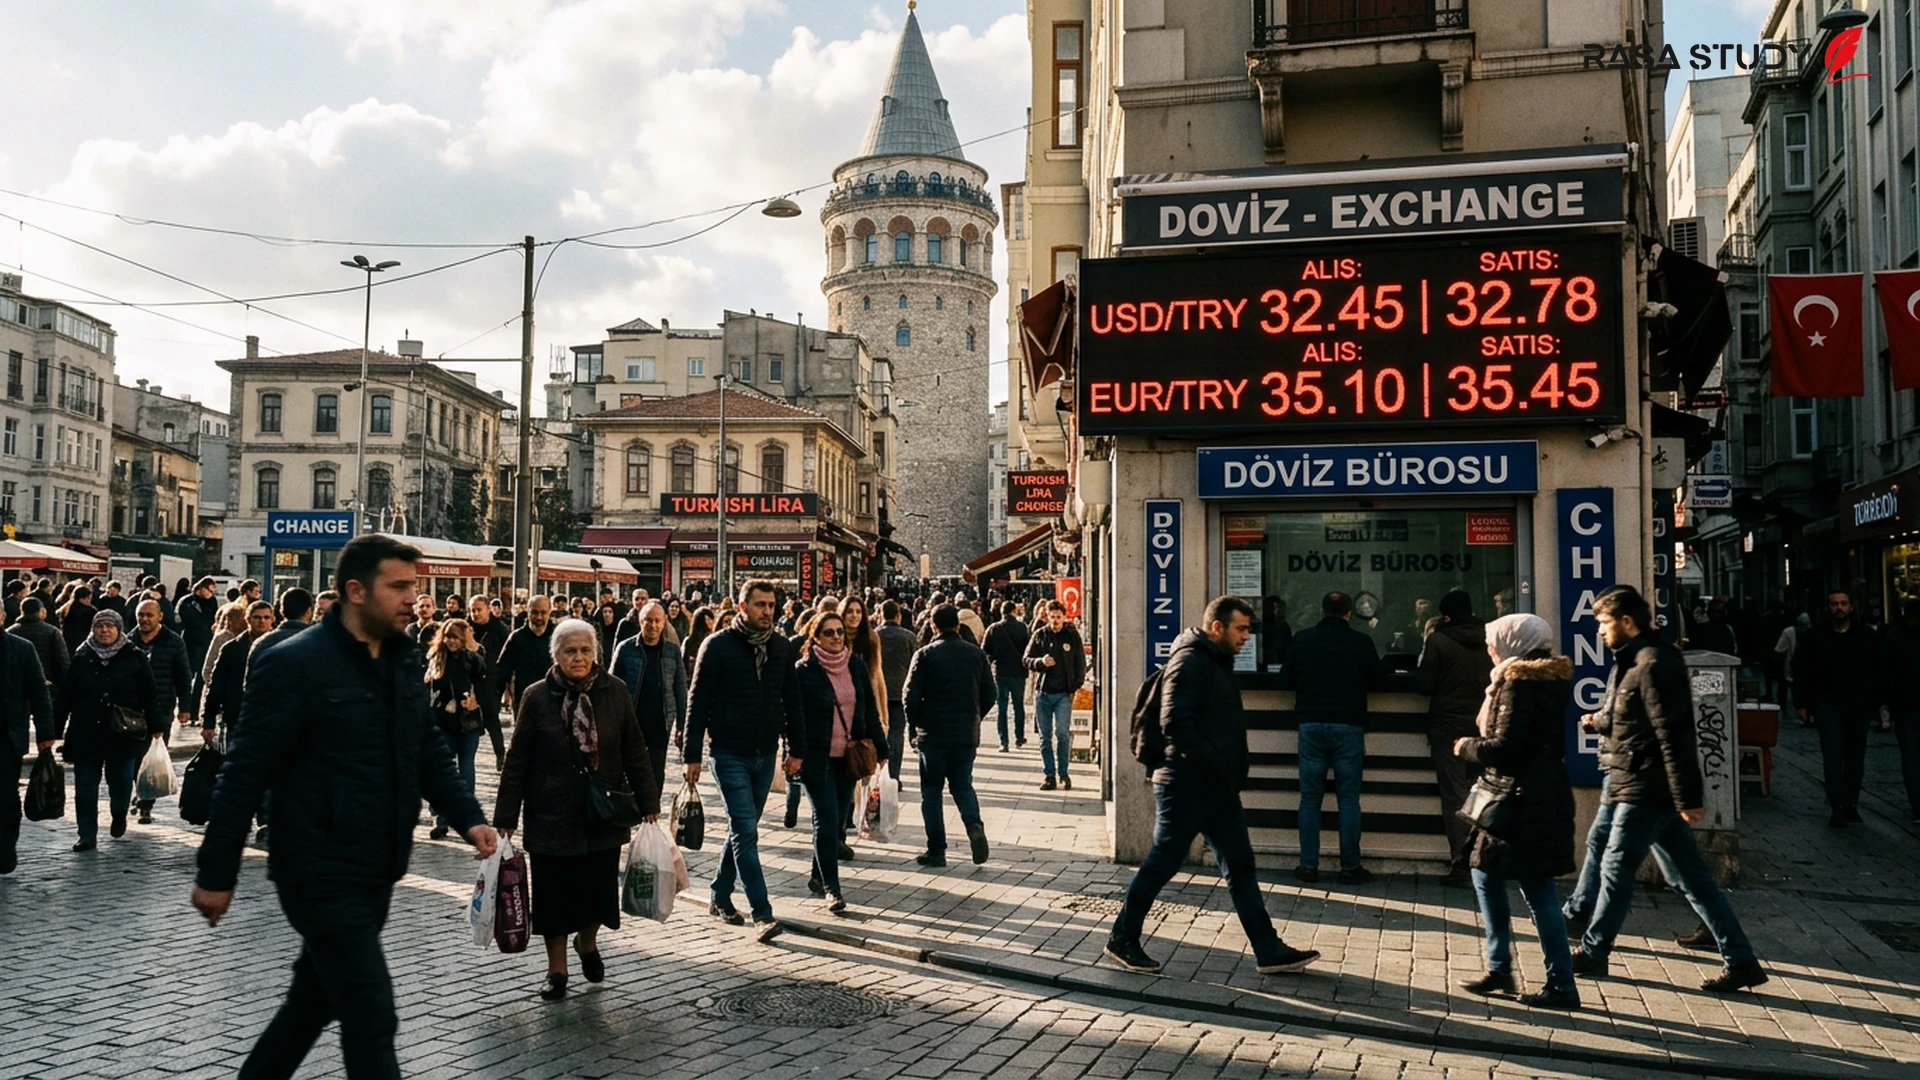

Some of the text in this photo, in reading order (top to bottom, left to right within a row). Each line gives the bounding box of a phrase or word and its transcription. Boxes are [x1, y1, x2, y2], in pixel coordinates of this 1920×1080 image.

[1160, 192, 1290, 238] DOVİZ
[1332, 180, 1585, 229] EXCHANGE
[1302, 250, 1558, 280] ALIS: SATIS:
[1090, 299, 1248, 335] USD/TRY
[1260, 285, 1405, 334] 32.45
[1447, 276, 1597, 327] 32.78
[1303, 334, 1560, 362] ALIS: SATIS:
[1090, 378, 1248, 413] EUR/TRY
[1260, 367, 1406, 416] 35.10
[1448, 361, 1600, 411] 35.45
[1224, 451, 1508, 488] DÖVİZ BÜROSU
[671, 495, 805, 513] TURKISH LİRA
[273, 519, 349, 534] CHANGE
[1152, 512, 1174, 614] DÖVİZ
[1288, 550, 1361, 573] DÖVİZ
[1370, 550, 1474, 573] BÜROSU
